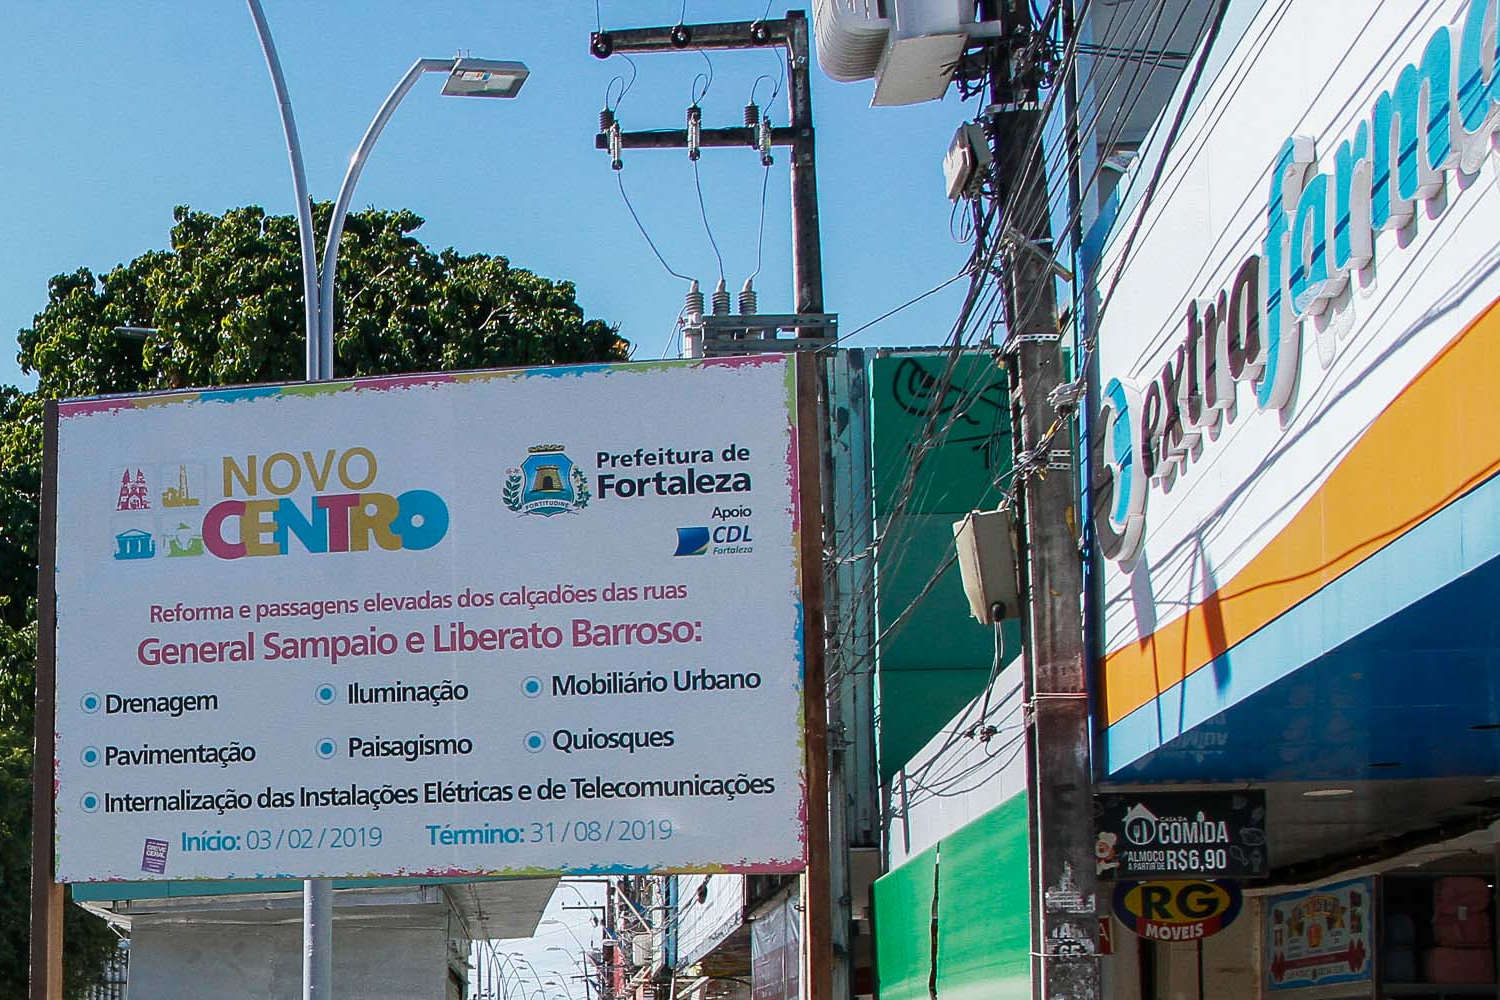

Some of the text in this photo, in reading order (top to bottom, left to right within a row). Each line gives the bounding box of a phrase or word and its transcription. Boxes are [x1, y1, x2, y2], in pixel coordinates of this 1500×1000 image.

[597, 444, 750, 468] Prefeitura de
[223, 446, 378, 498] NOVO
[598, 468, 752, 499] Fortaleza
[201, 489, 449, 559] CENTRO
[711, 505, 752, 521] Apoio
[712, 525, 753, 543] CDL
[713, 546, 753, 555] Fortaleza
[150, 582, 687, 623] Reforma e passagens elevadas dos calçadões das ruas
[138, 618, 702, 666] General Sampaio e Liberato Barroso:
[348, 680, 469, 706] Iluminação
[552, 669, 762, 696] Mobiliário Urbano
[105, 694, 218, 717] Drenagem
[348, 734, 473, 761] Paisagismo
[552, 728, 675, 753] Quiosques
[105, 741, 257, 768] Pavimentação
[104, 773, 775, 815] Internalização das Instalações Elétricas e de Telecomunicações
[425, 823, 525, 845] Término:
[1158, 811, 1229, 844] COMIDA
[181, 831, 241, 851] Início:
[1167, 848, 1226, 872] R$6,90
[1142, 884, 1219, 919] RG
[1146, 922, 1204, 941] MÓVEIS
